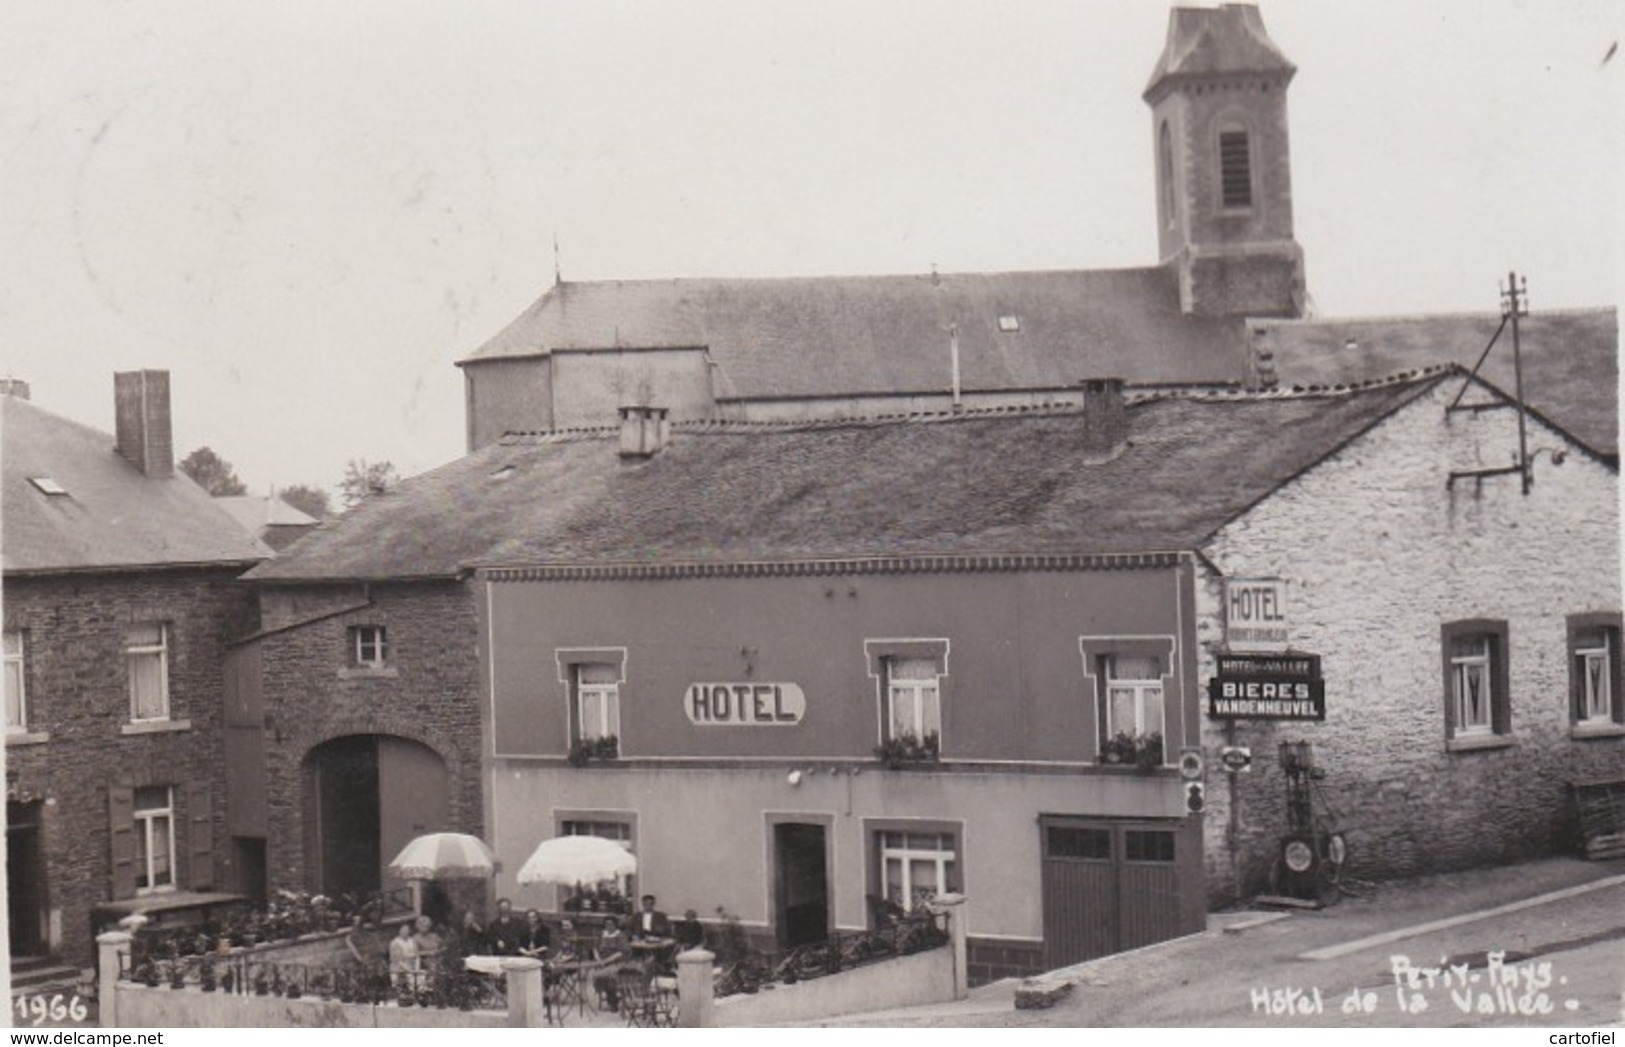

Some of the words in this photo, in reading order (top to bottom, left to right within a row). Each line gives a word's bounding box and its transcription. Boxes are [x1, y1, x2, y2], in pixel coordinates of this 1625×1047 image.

[1230, 587, 1284, 621] HOTEL
[692, 685, 797, 721] HOTEL
[1222, 683, 1309, 698] BIERES
[1215, 699, 1319, 716] VANDENHEUVEL
